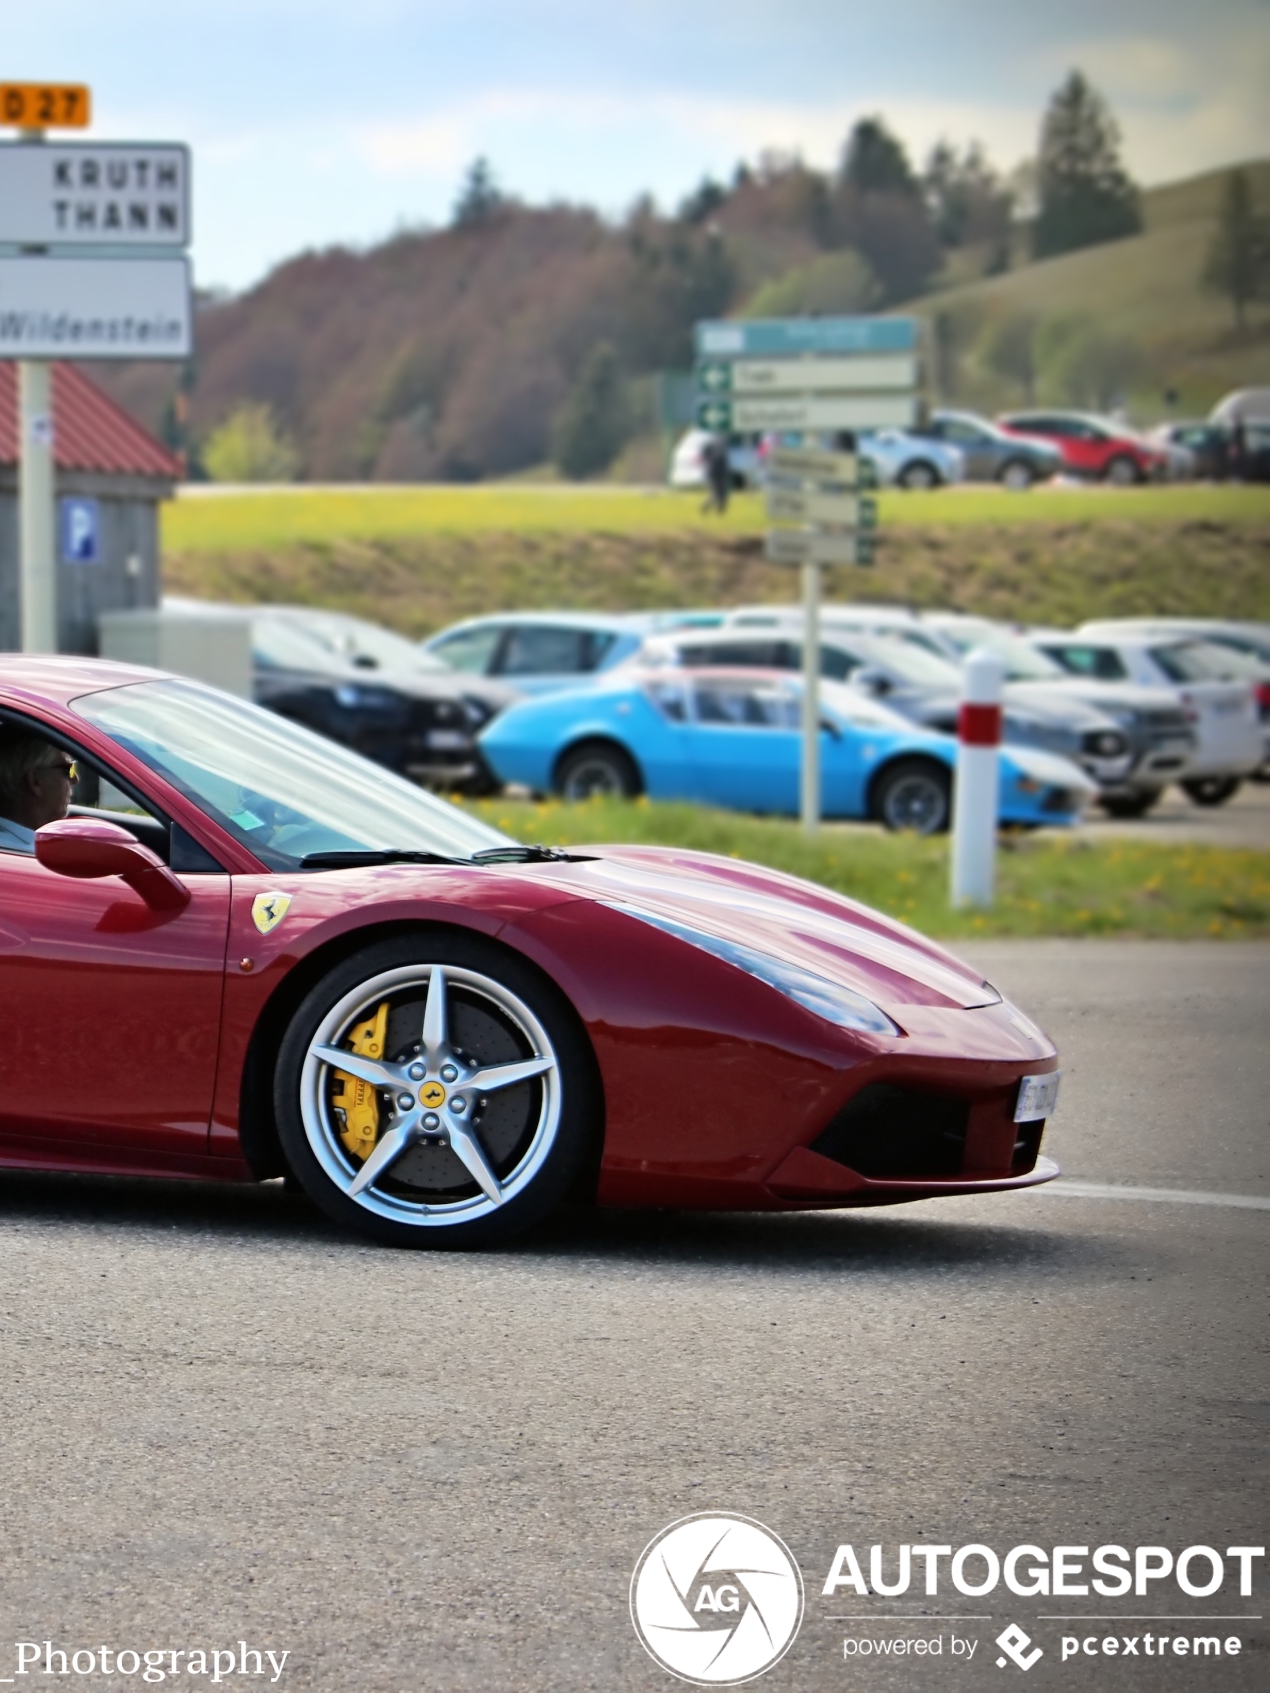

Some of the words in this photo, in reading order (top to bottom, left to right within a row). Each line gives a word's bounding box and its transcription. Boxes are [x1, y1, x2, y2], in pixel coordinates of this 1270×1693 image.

[4, 89, 26, 121] D
[37, 89, 81, 123] 27
[53, 158, 180, 191] KRUTH
[51, 201, 180, 233] THANN
